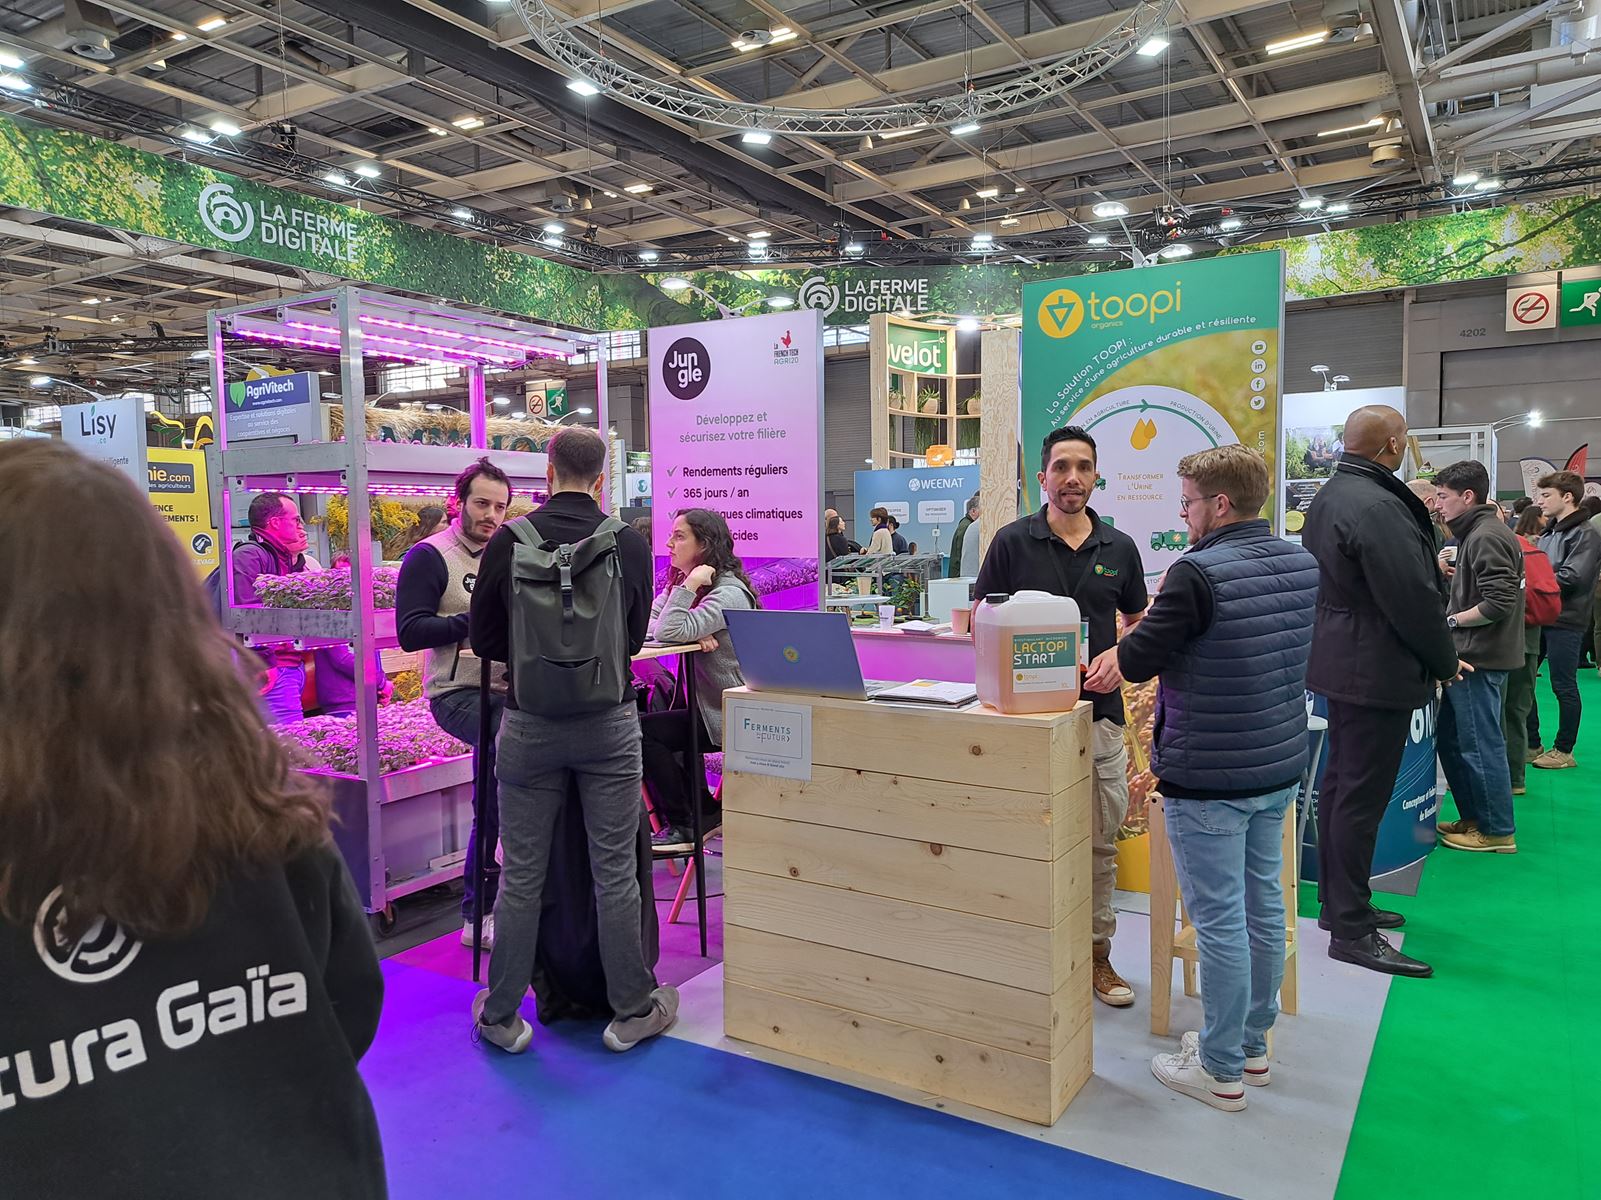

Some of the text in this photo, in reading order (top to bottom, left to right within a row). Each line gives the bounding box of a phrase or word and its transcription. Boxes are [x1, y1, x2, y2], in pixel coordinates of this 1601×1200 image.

[260, 200, 358, 241] LA FERME
[261, 222, 359, 263] DIGITALE
[845, 279, 929, 295] LA FERME
[845, 295, 929, 312] DIGITALE
[1088, 280, 1181, 324] toopi
[1091, 320, 1123, 329] organics
[1460, 327, 1486, 338] 4202
[668, 351, 698, 368] Jun
[678, 366, 702, 388] gle
[1046, 400, 1060, 415] La
[1057, 364, 1093, 400] Solution
[1092, 338, 1127, 364] TOOPI
[1051, 315, 1256, 427] Au service d'une agriculture durable et résiliente
[246, 379, 294, 399] AgriVitech
[1093, 400, 1130, 420] AGRICULTURE
[81, 406, 117, 438] Lisy
[696, 411, 768, 428] Développez et
[1170, 400, 1223, 440] PRODUCTION D'URINE
[679, 428, 786, 443] sécurisez votre filière
[683, 464, 788, 478] Rendements réguliers
[921, 477, 965, 489] WEENAT
[683, 488, 702, 498] 365
[703, 488, 728, 500] jours
[737, 488, 749, 497] an
[746, 508, 803, 521] climatiques
[1014, 641, 1067, 653] LACTOPI
[1014, 653, 1056, 665] START
[744, 718, 791, 735] FERMENTS
[156, 964, 308, 1050] Gaïa
